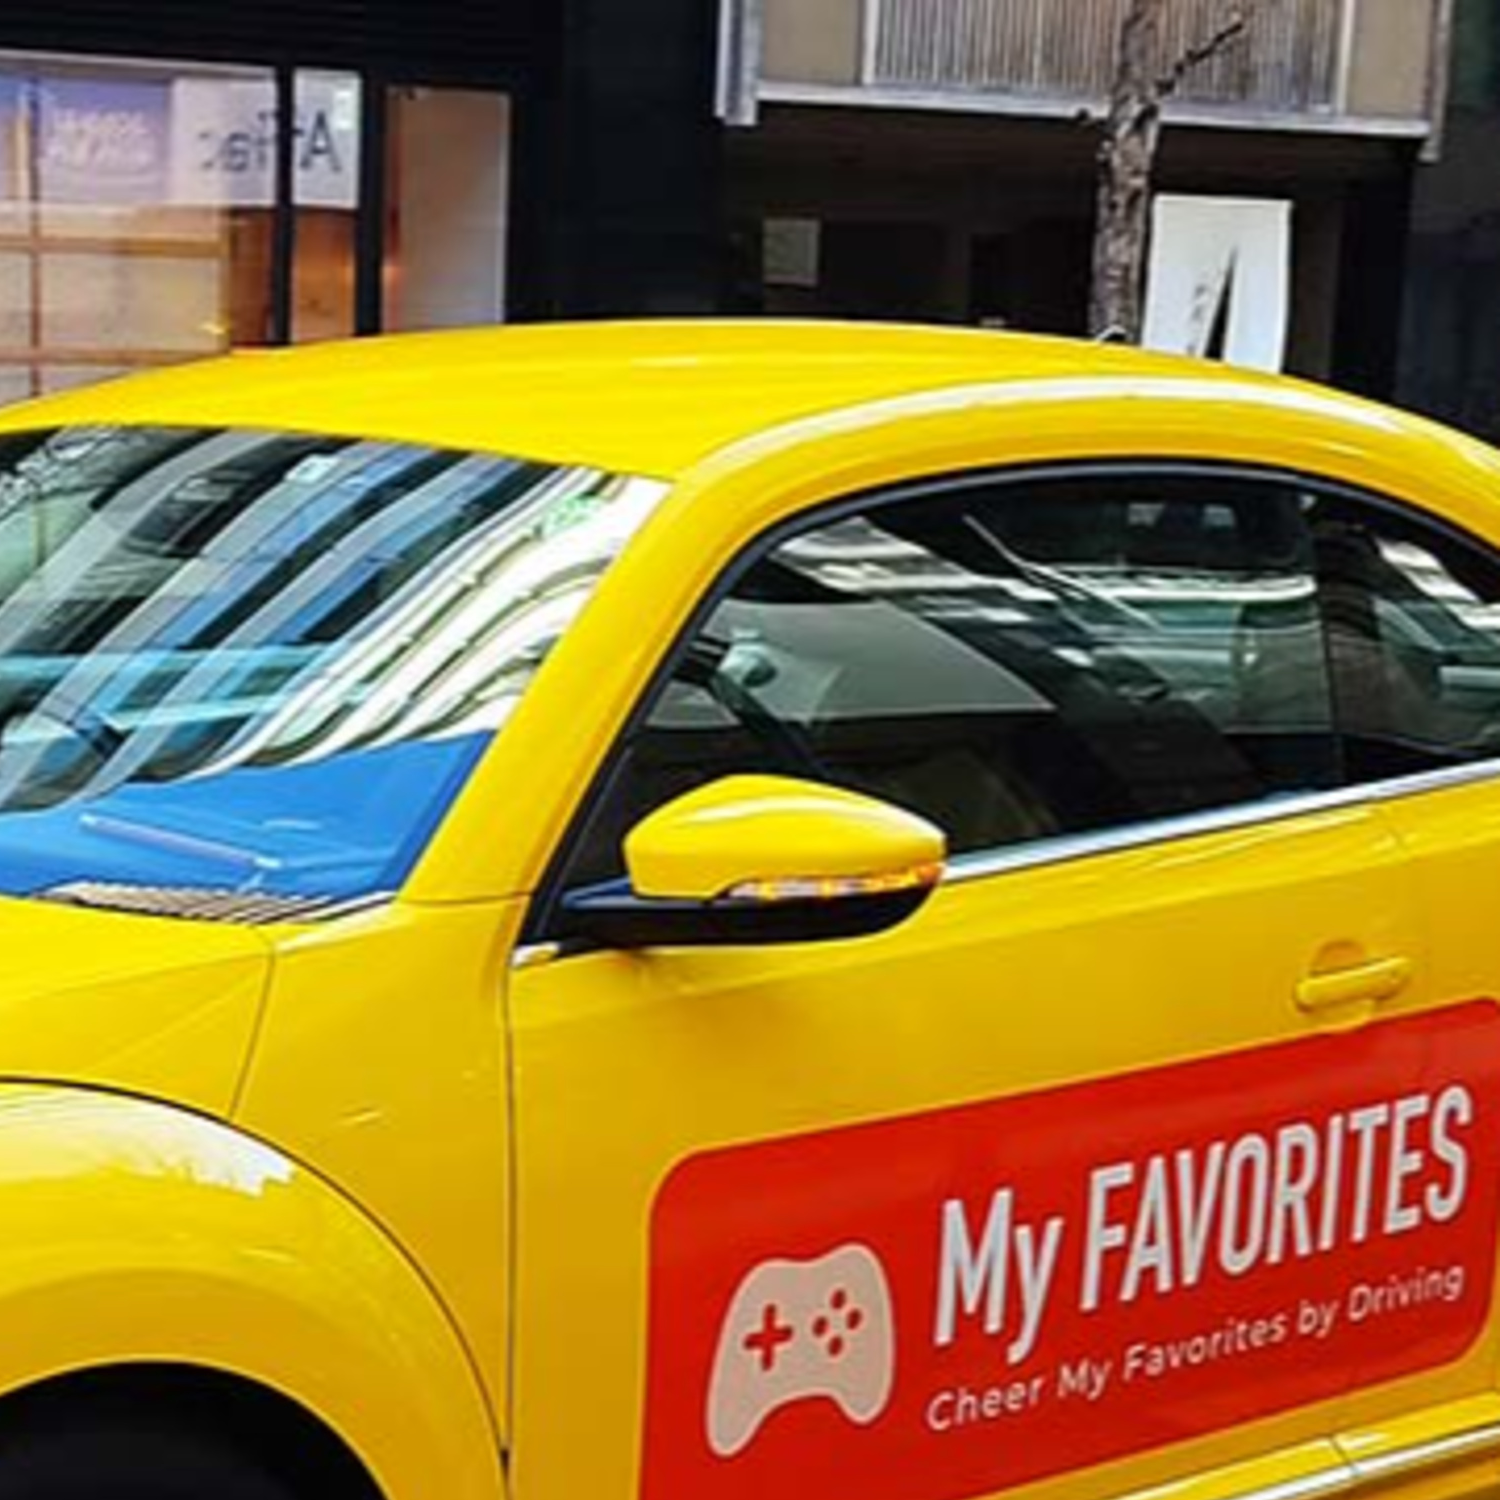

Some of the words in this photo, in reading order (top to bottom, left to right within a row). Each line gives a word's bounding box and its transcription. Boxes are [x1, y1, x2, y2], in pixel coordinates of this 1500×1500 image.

[933, 1186, 1065, 1365] My
[1080, 1085, 1474, 1311] FAVORITES
[925, 1376, 1046, 1432] Cheer
[1056, 1357, 1115, 1401] My
[1123, 1313, 1289, 1382] Favorites
[1296, 1299, 1339, 1339] by
[1348, 1264, 1466, 1322] Driving
